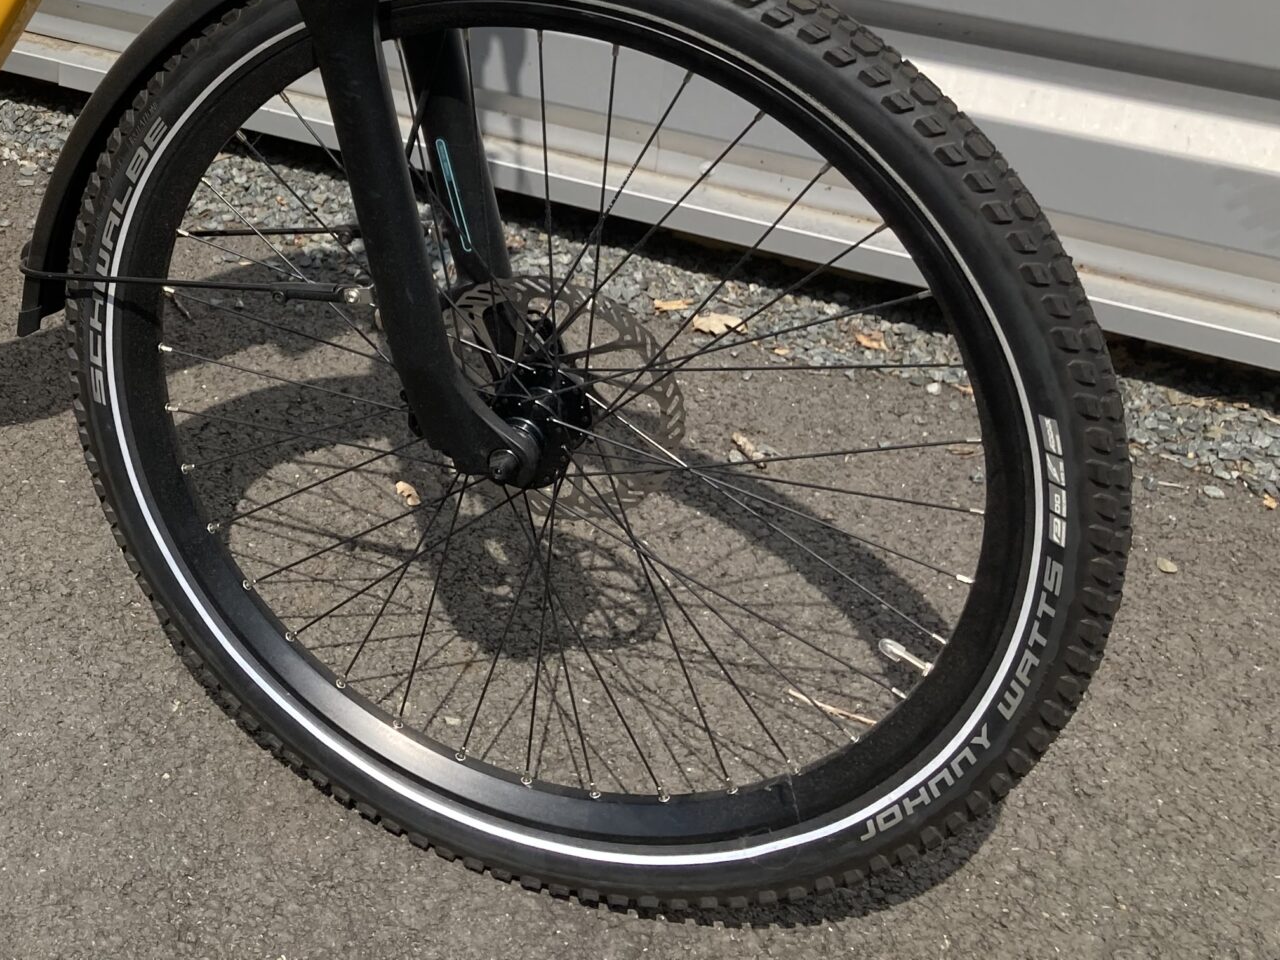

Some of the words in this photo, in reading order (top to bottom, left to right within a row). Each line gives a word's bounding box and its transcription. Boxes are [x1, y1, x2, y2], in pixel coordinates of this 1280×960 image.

[89, 116, 168, 407] SCHWALBE
[860, 722, 992, 841] JOHNNY
[997, 555, 1064, 721] WATTS
